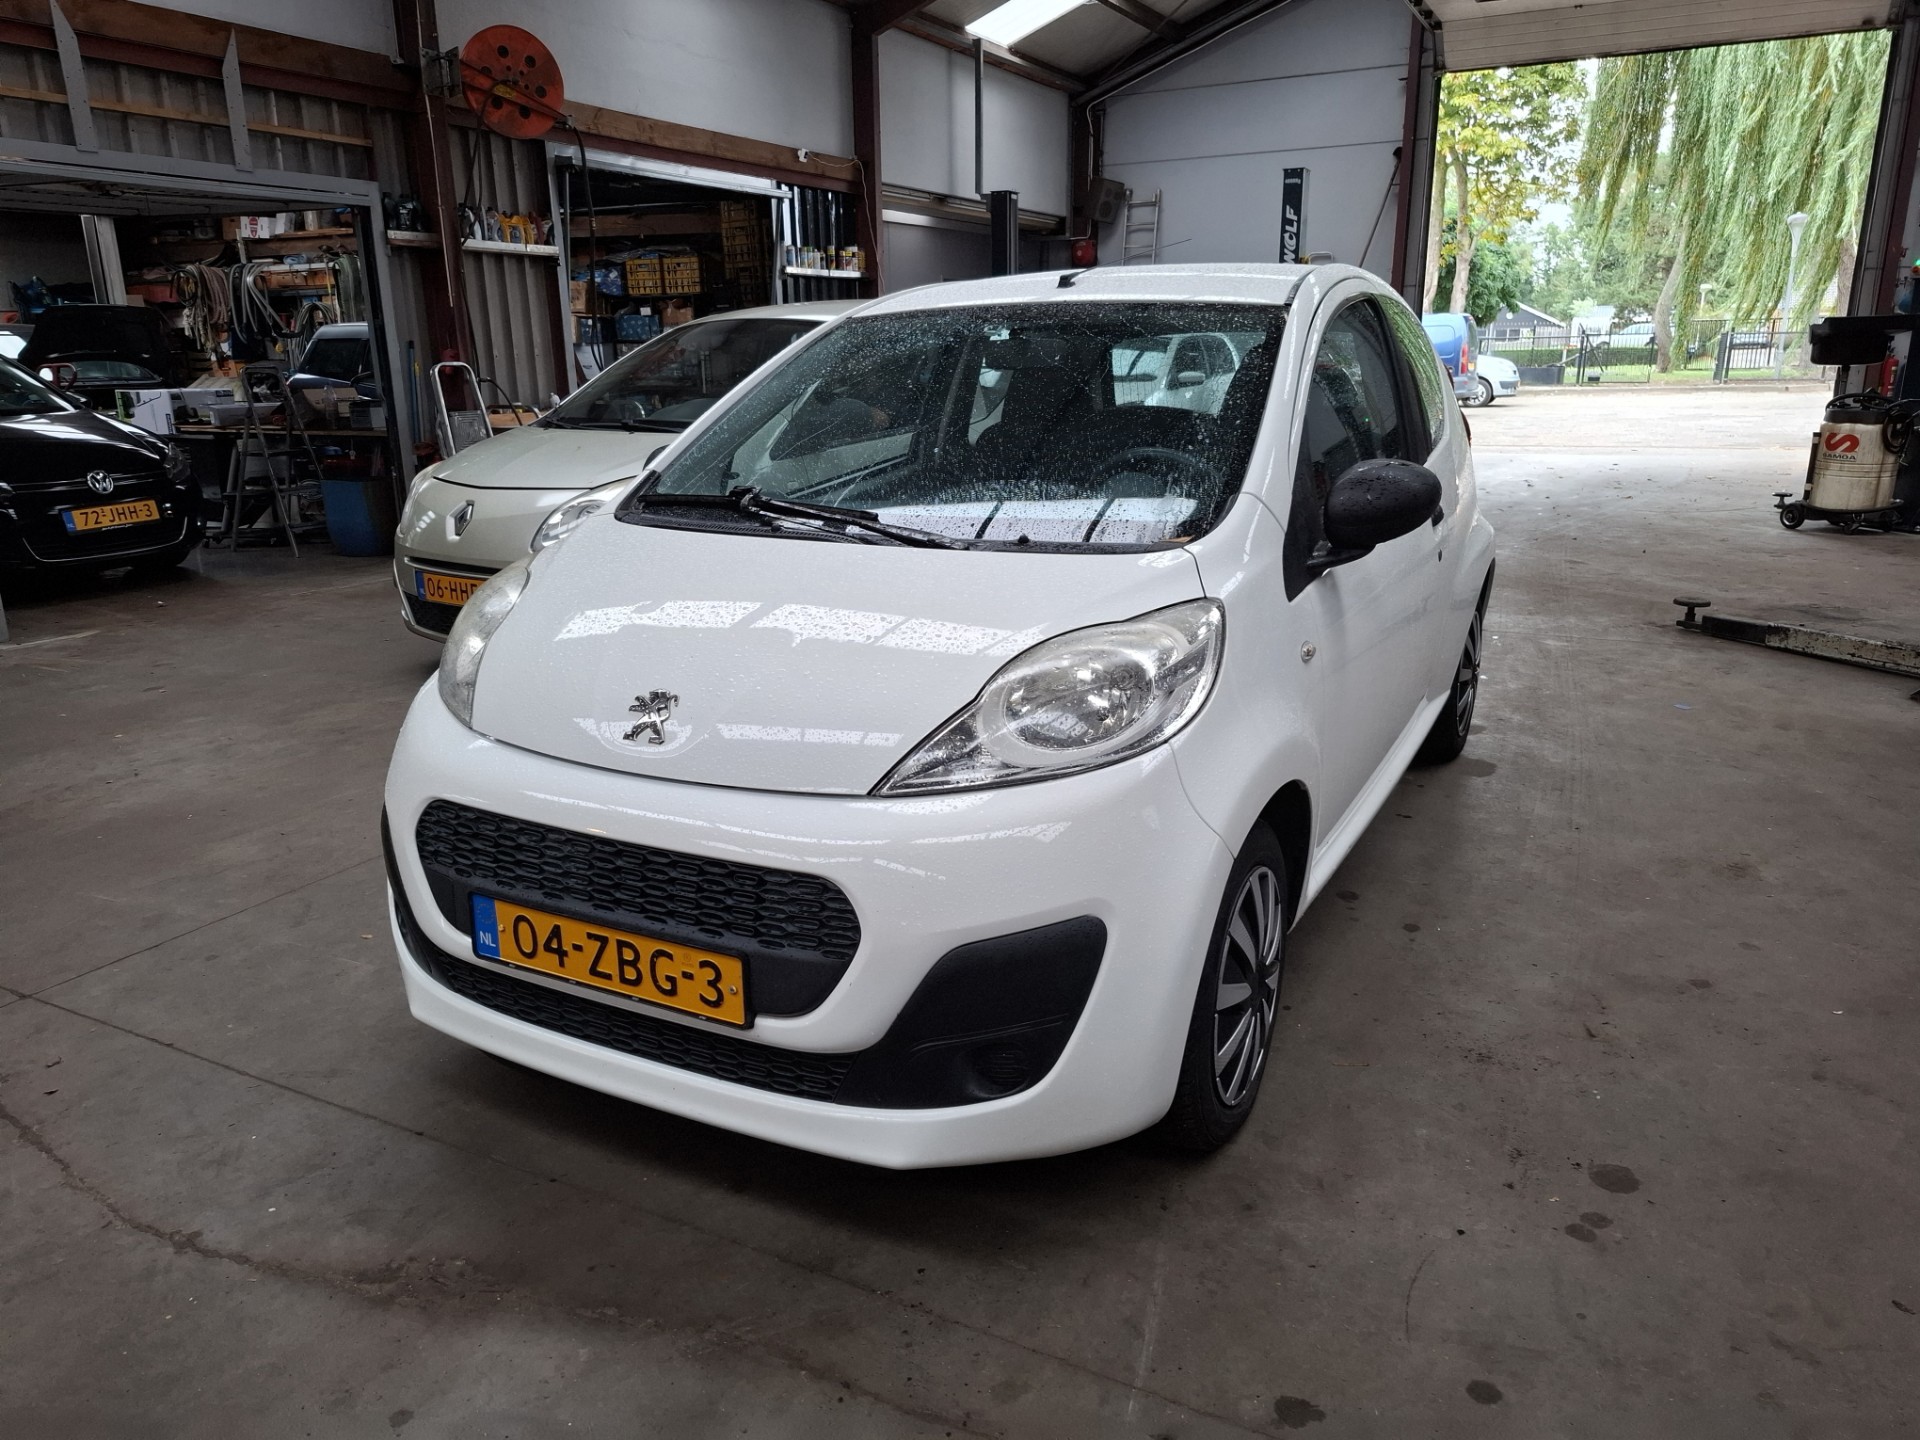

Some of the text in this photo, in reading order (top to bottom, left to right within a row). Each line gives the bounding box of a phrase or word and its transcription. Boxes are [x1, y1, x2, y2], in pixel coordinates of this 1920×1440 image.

[1283, 204, 1298, 264] WOLF
[79, 503, 153, 526] 72-JHH-3
[479, 930, 497, 948] NL
[511, 913, 726, 1009] 04-ZBG-3
